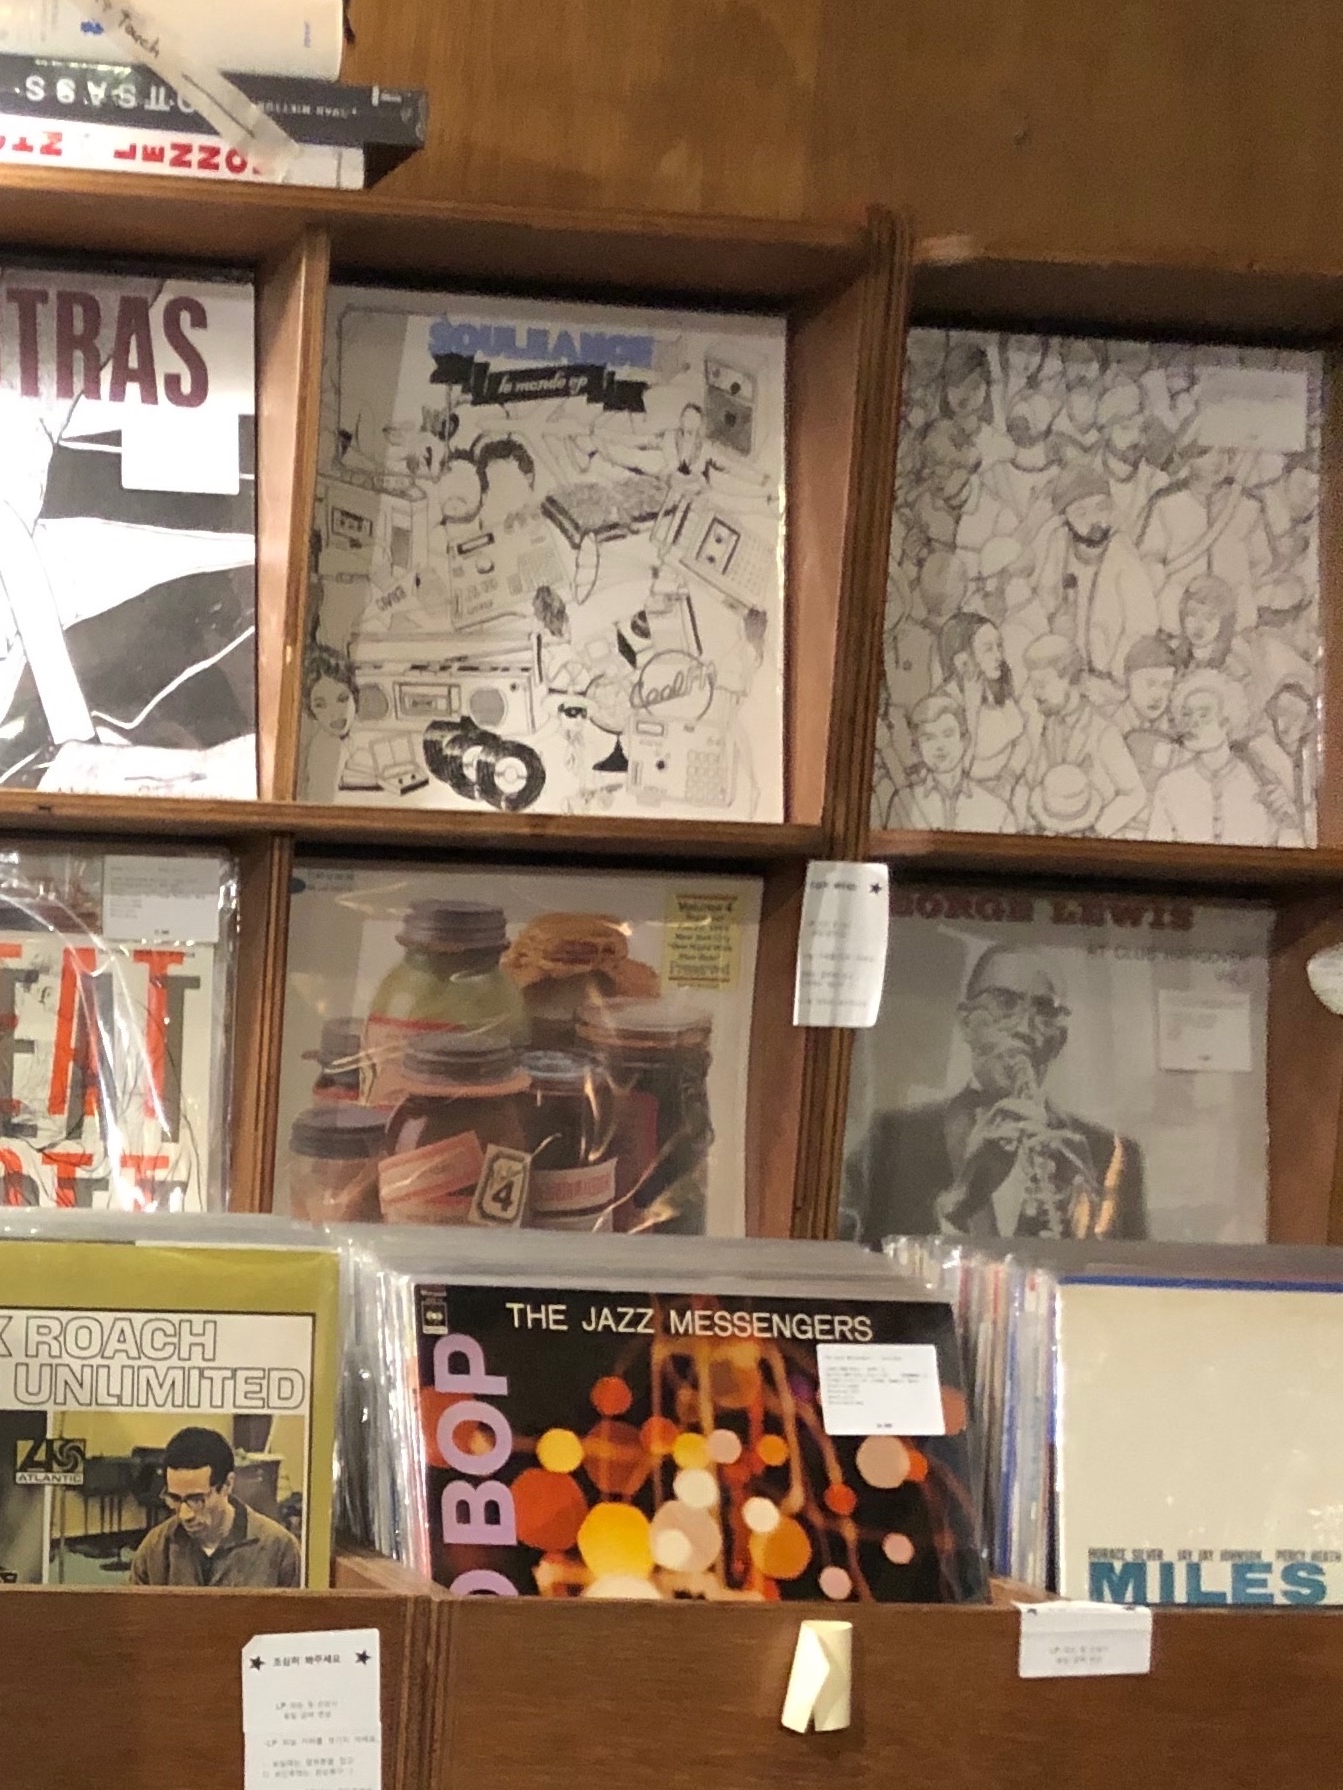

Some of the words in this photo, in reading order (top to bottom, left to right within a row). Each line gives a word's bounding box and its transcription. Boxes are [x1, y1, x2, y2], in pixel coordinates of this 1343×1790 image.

[490, 1184, 513, 1212] 4
[24, 1316, 218, 1362] ROACH
[506, 1302, 568, 1331] THE
[581, 1306, 657, 1334] JAZZ
[670, 1309, 874, 1343] MESSENGERS
[14, 1363, 306, 1410] UNLIMITED
[434, 1333, 519, 1546] BOP
[17, 1473, 82, 1483] ATLANTIC
[1088, 1560, 1328, 1605] MILES
